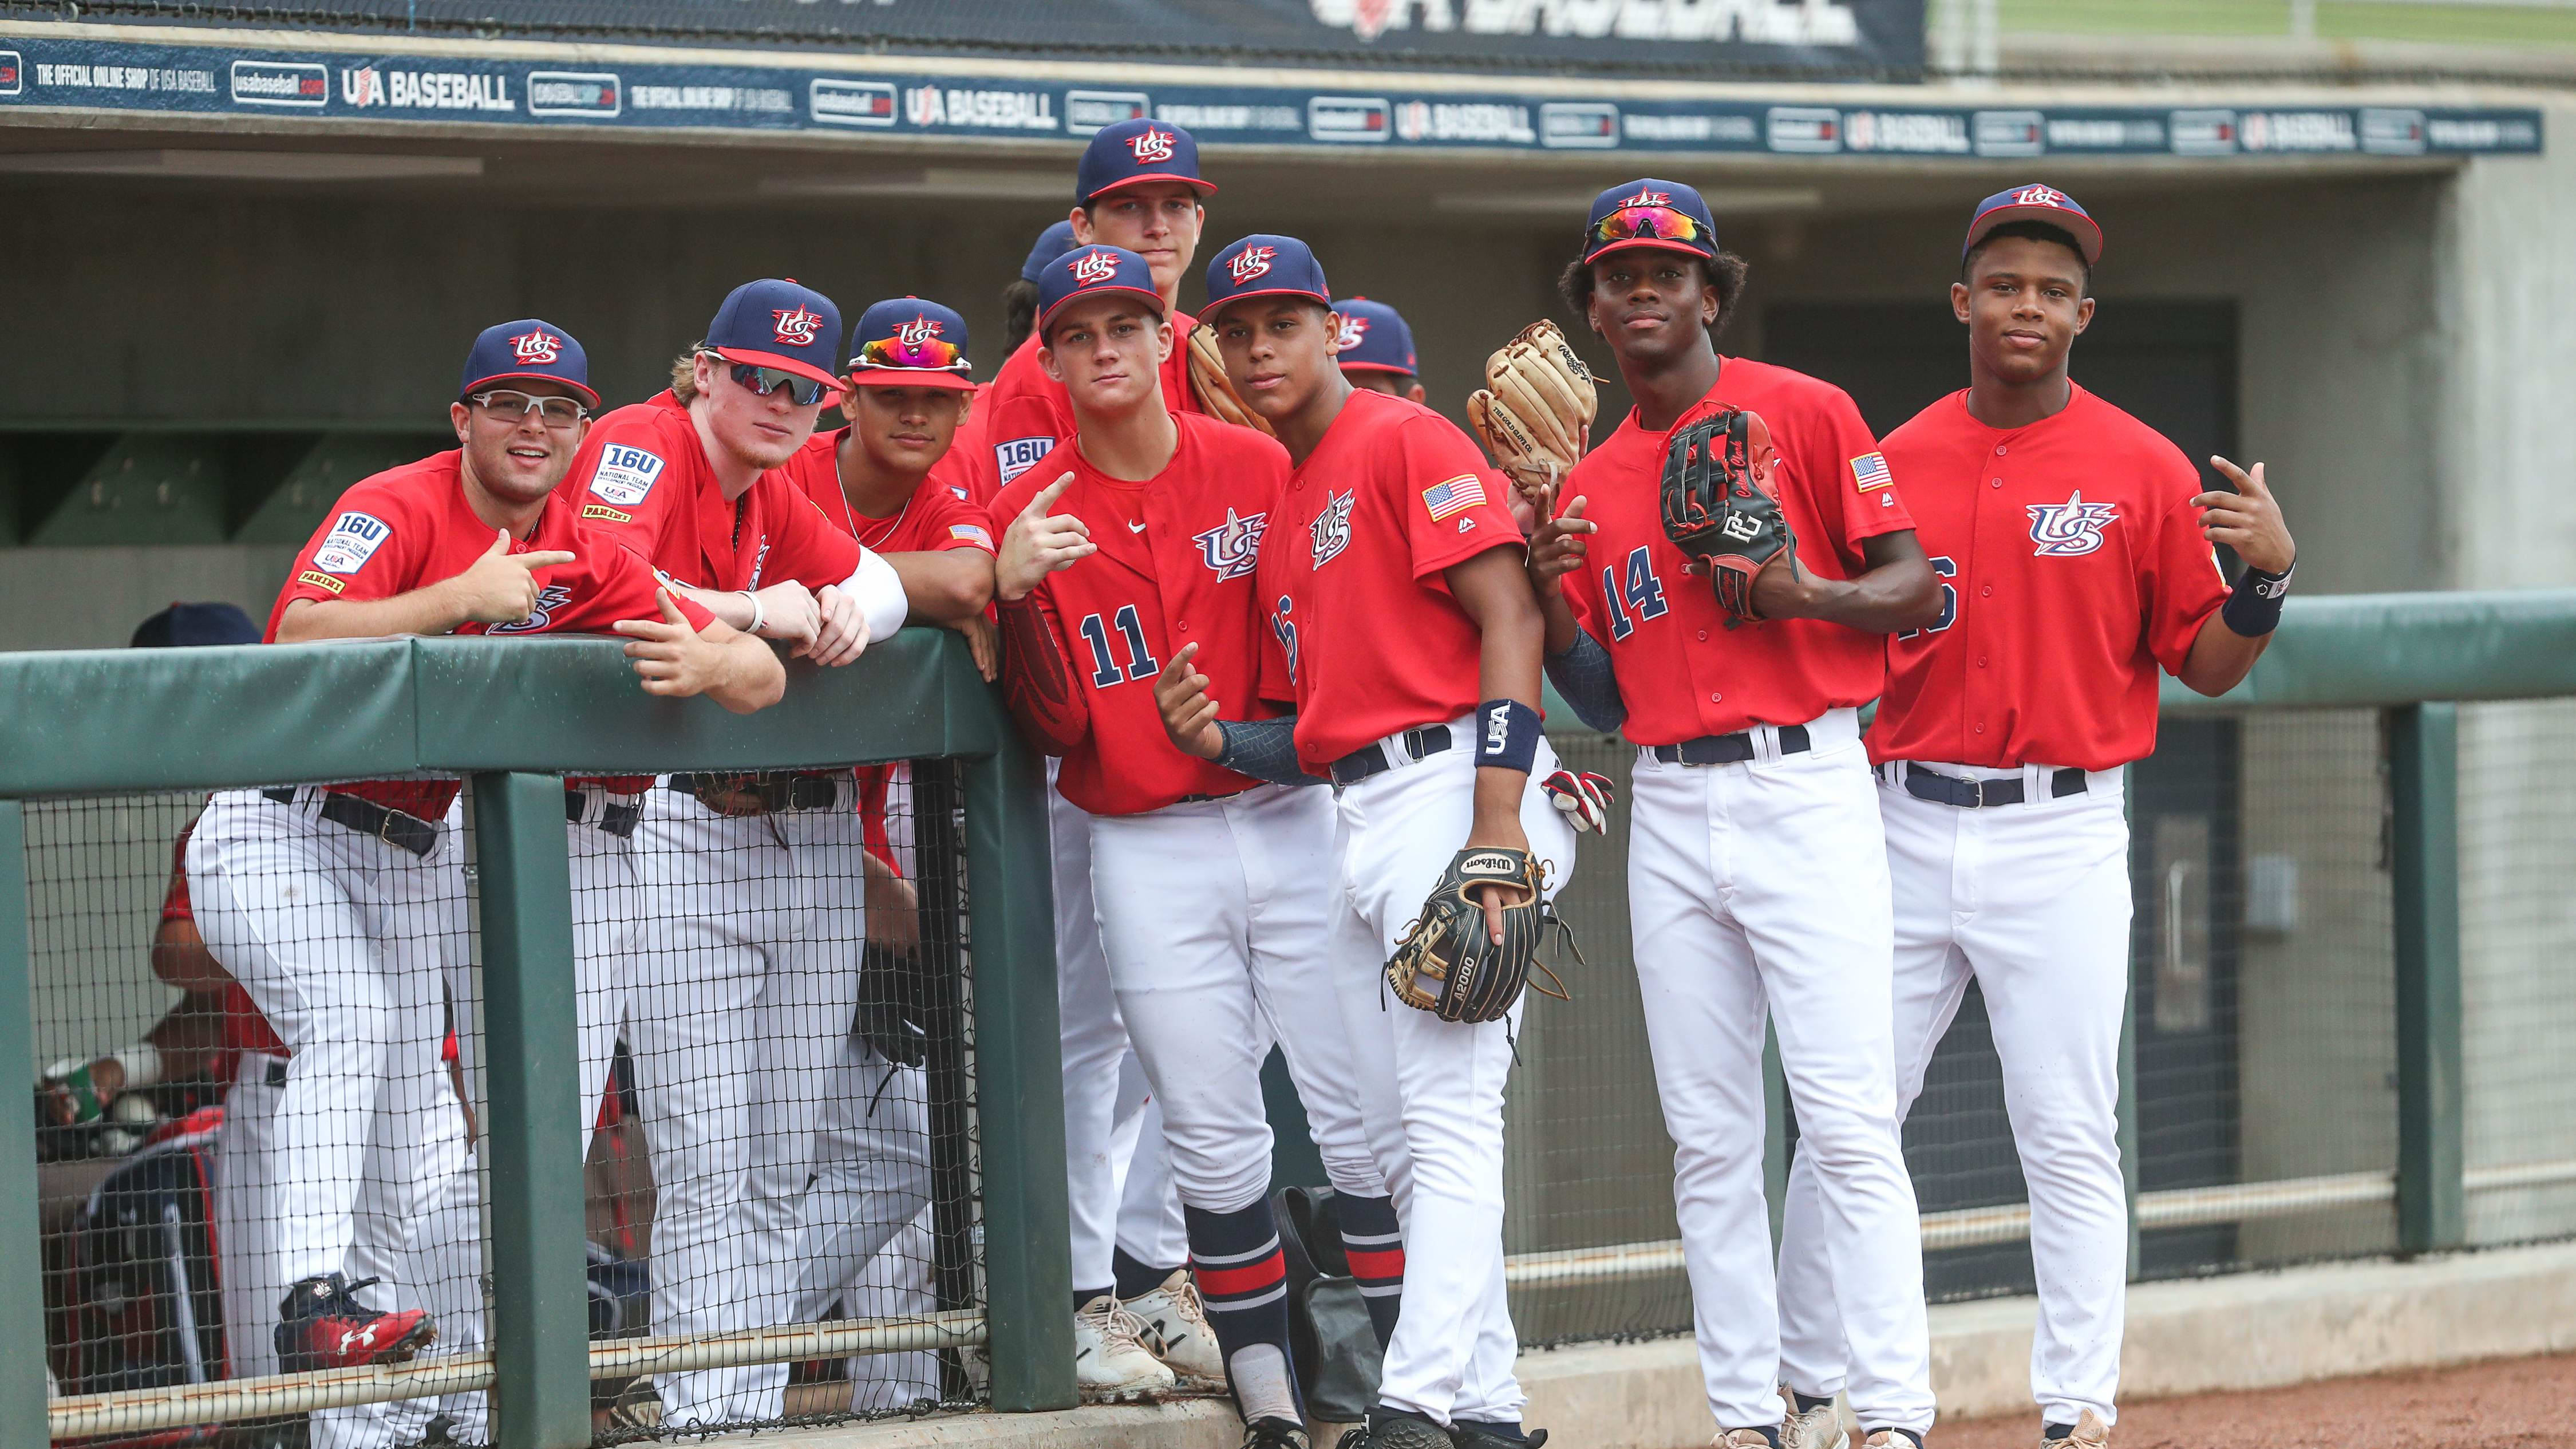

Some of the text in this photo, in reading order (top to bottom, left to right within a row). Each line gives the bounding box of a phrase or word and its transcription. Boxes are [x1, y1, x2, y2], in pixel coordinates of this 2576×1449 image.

[37, 64, 54, 85] THE
[54, 64, 92, 86] OFFICIAL
[93, 65, 124, 88] ONLINE
[125, 67, 148, 90] SHOP
[177, 70, 216, 92] BASEBALL
[235, 72, 324, 94] usabaseball.com
[343, 66, 386, 108] USA
[390, 70, 515, 110] BASEBALL
[947, 89, 1058, 130] BASEBALL
[1557, 344, 1593, 386] Rawlings
[1492, 406, 1503, 418] THE
[1502, 414, 1515, 431] GOLD
[1512, 427, 1527, 447] GLOVE
[607, 447, 657, 474] 16U
[1003, 441, 1046, 467] 16U
[1729, 440, 1746, 467] Clark
[599, 471, 649, 487] NATIONAL TEAM
[626, 481, 646, 492] PROGRAM
[584, 507, 629, 521] PANINI
[336, 515, 382, 541] 16U
[326, 538, 369, 556] NATIONAL TEAM
[301, 573, 342, 591] PANINI
[1603, 544, 1670, 642] 14
[1079, 603, 1160, 689] 11
[1485, 704, 1511, 755] USA
[1465, 858, 1511, 871] Wilson
[1453, 956, 1475, 1001] A2000
